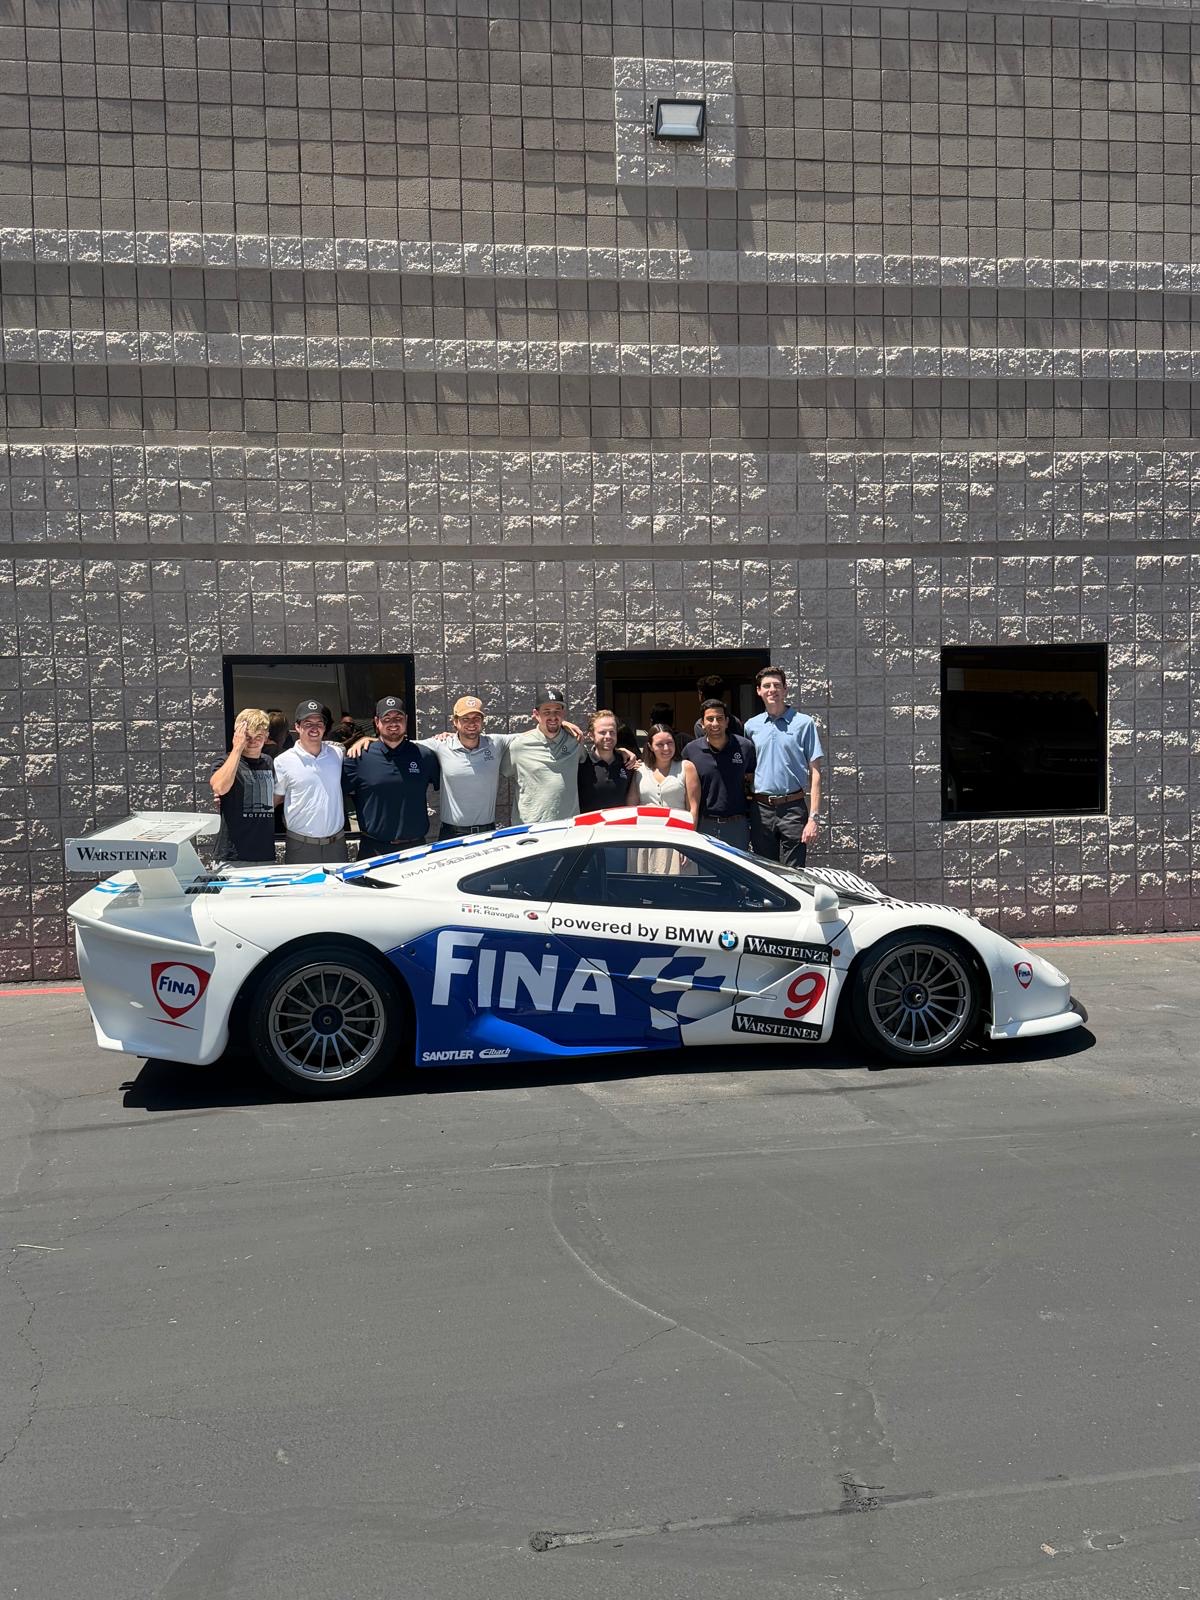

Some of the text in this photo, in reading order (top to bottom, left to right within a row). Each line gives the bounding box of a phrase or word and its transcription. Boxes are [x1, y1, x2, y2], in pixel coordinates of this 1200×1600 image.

[76, 847, 168, 861] WARSTEINER
[551, 916, 631, 935] powered
[638, 923, 659, 941] by
[665, 926, 714, 944] BMW
[747, 937, 829, 962] WARSTEINER
[431, 930, 617, 1016] FINA
[158, 975, 196, 997] FINA
[784, 972, 826, 1018] 9
[736, 1015, 819, 1039] WARSTEINER
[421, 1050, 474, 1062] SANDTLER
